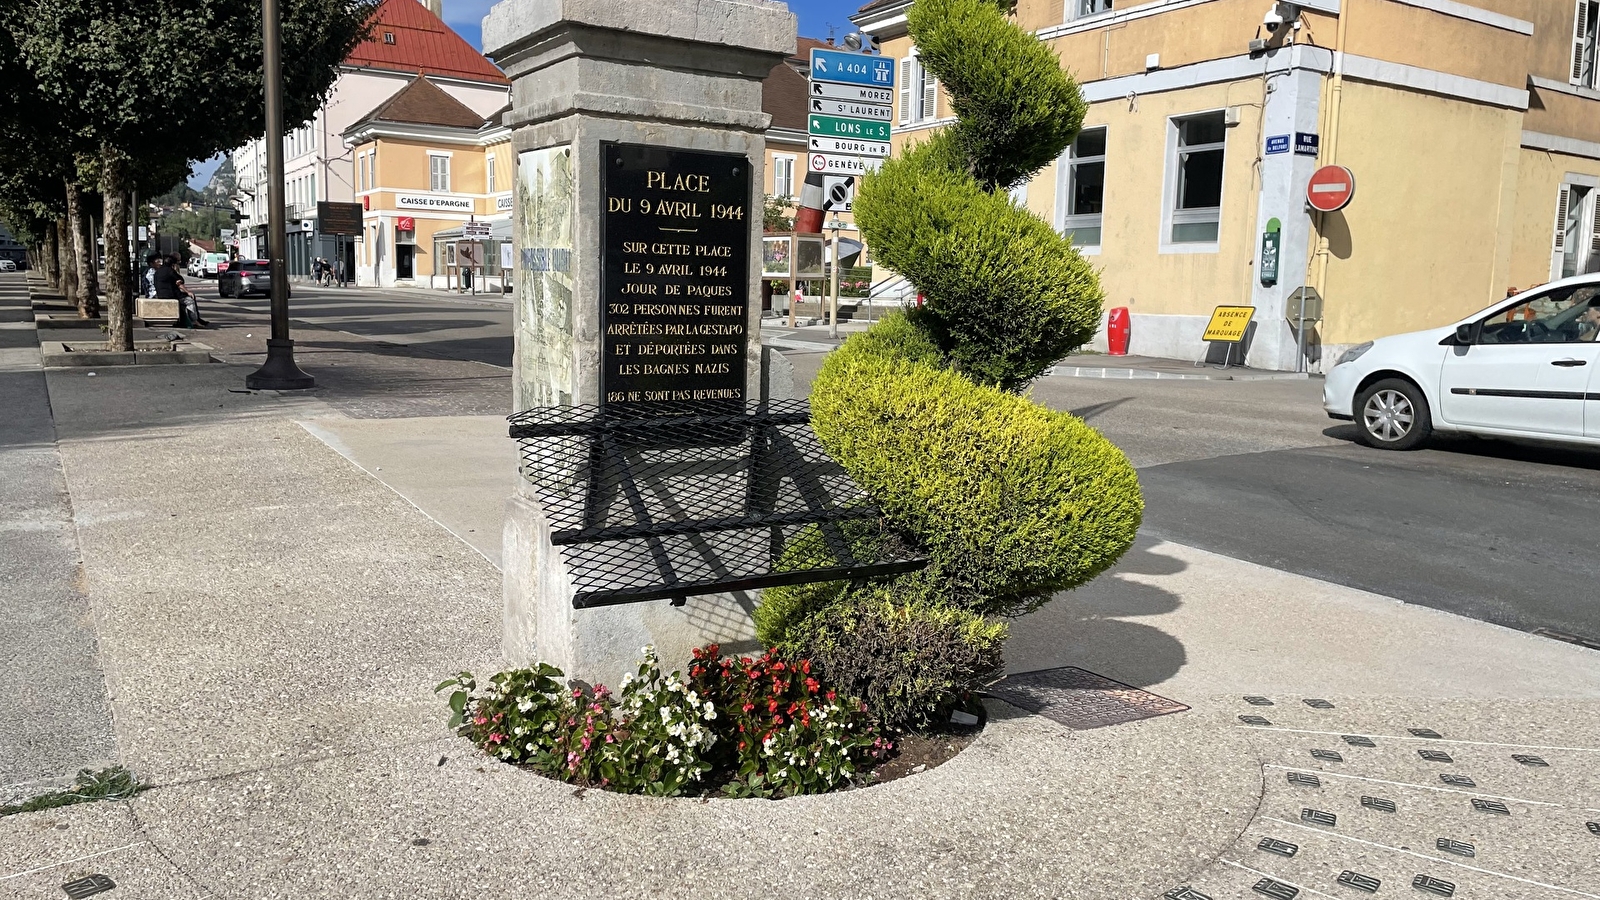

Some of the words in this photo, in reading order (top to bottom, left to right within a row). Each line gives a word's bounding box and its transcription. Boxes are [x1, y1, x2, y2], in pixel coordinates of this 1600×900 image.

[838, 62, 844, 72] A
[846, 63, 867, 75] 404
[860, 90, 891, 101] MOREZ
[850, 106, 891, 117] LAURENT
[835, 122, 861, 134] LONS
[879, 126, 888, 137] S.
[1303, 135, 1312, 143] RUE
[835, 141, 865, 152] BOURG
[881, 145, 888, 154] B.
[1295, 144, 1318, 153] LAMARTINE
[828, 159, 864, 170] GENÈVE
[646, 170, 710, 193] PLACE
[400, 197, 428, 206] CAISSE
[429, 199, 470, 208] D'EPARGNE
[608, 196, 632, 214] DU
[640, 198, 651, 215] 9
[655, 199, 702, 219] AVRIL
[710, 203, 744, 220] 1944
[622, 241, 648, 255] SUR
[651, 242, 691, 256] CETTE
[695, 244, 732, 258] PLACE
[624, 262, 641, 275] LE
[646, 263, 655, 275] 9
[658, 263, 693, 277] AVRIL
[699, 264, 728, 277] 1944
[621, 283, 657, 296] JOUR
[664, 284, 681, 296] DE
[687, 284, 732, 298] PAQUES
[608, 303, 630, 315] 302
[633, 303, 701, 316] PERSONNES
[703, 304, 743, 317] FURENT
[1218, 311, 1248, 319] ABSENCE
[664, 323, 685, 336] PAR
[686, 323, 699, 335] LA
[699, 323, 743, 336] GESTAPO
[1206, 329, 1242, 337] MARQUAGE
[615, 343, 632, 356] ET
[637, 341, 706, 357] DÉPORTÉES
[711, 343, 738, 355] DANS
[618, 364, 640, 376] LES
[643, 363, 690, 375] BAGNES
[695, 362, 730, 375] NAZIS
[607, 391, 625, 403] 186
[627, 390, 641, 402] NE
[644, 390, 671, 402] SONT
[672, 389, 691, 401] PAS
[693, 388, 741, 401] REVENUES
